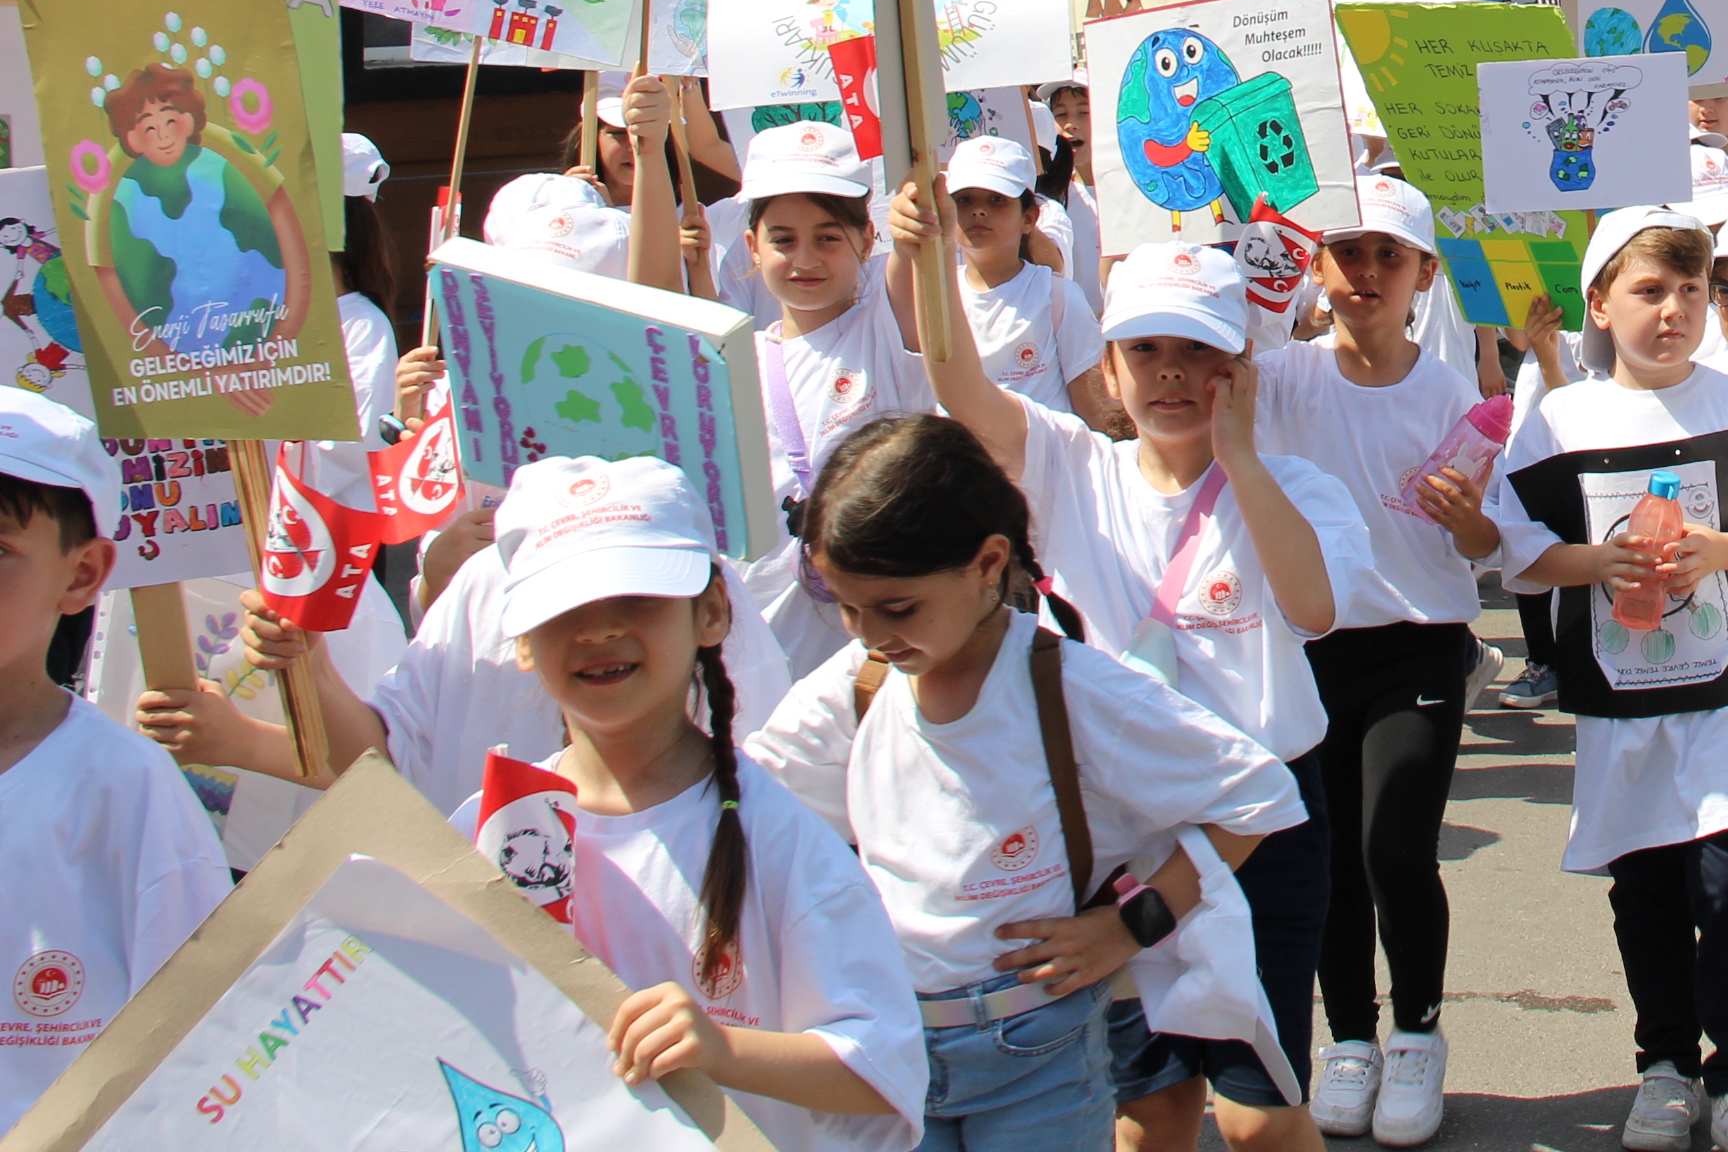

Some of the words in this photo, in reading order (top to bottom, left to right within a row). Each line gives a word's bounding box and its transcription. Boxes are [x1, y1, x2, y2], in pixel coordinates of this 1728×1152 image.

[393, 6, 435, 21] ATMAYIN
[1232, 8, 1289, 29] Dönüşüm
[1244, 26, 1306, 47] Muhteşem
[1261, 42, 1323, 64] Olacak!!!!!
[1414, 38, 1454, 55] HER
[1424, 63, 1474, 79] TEMİZ
[770, 86, 818, 98] eTwinning
[1384, 101, 1423, 116] HER
[1444, 170, 1484, 183] OLUR
[1504, 282, 1532, 293] Plastik
[1555, 284, 1578, 294] Cam
[130, 305, 190, 352] Enerji
[190, 292, 290, 340] Tasarrufu
[129, 339, 257, 378] GELECEĞİMİZ
[256, 335, 299, 368] İÇİN
[112, 385, 138, 407] EN
[139, 370, 213, 404] ÖNEMLİ
[214, 361, 332, 394] YATIRIMDIR!
[375, 474, 399, 517] ATA
[334, 542, 373, 600] ATA
[196, 1073, 243, 1125] SU
[235, 934, 374, 1082] HAYATTIR
[748, 1016, 760, 1027] VE
